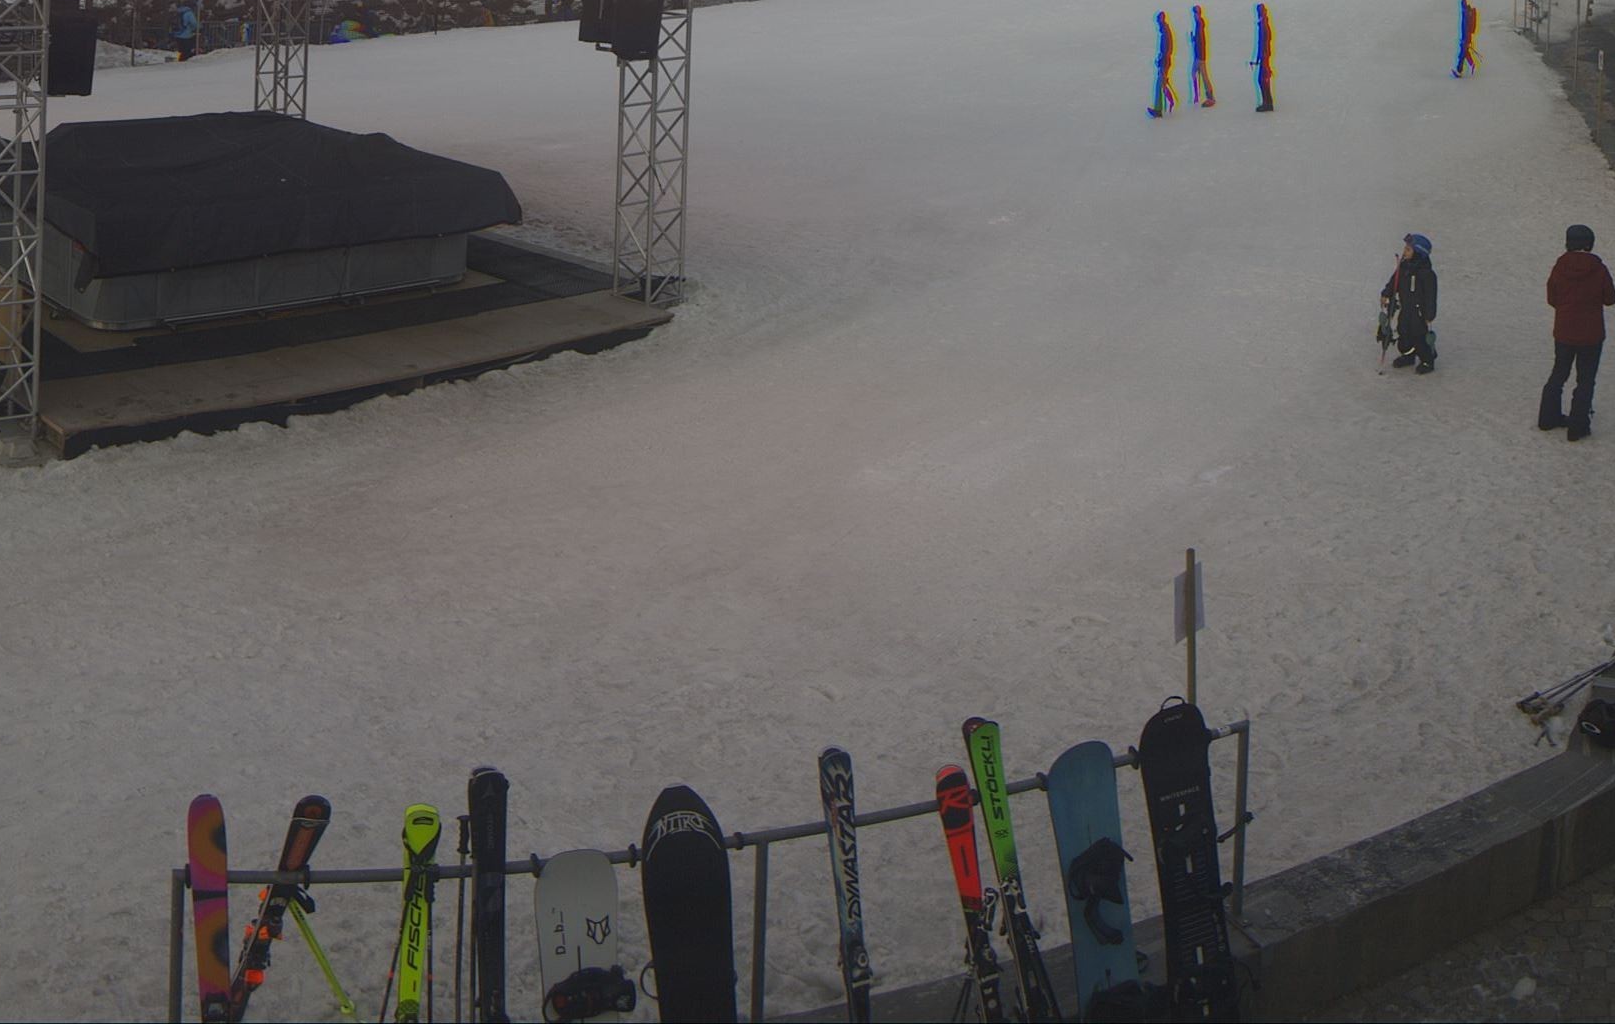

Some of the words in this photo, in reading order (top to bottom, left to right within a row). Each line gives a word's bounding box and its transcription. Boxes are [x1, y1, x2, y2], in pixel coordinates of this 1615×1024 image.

[981, 735, 1005, 821] STÖCKLI
[834, 771, 861, 920] DYNASTAR
[407, 873, 423, 972] FISCHE
